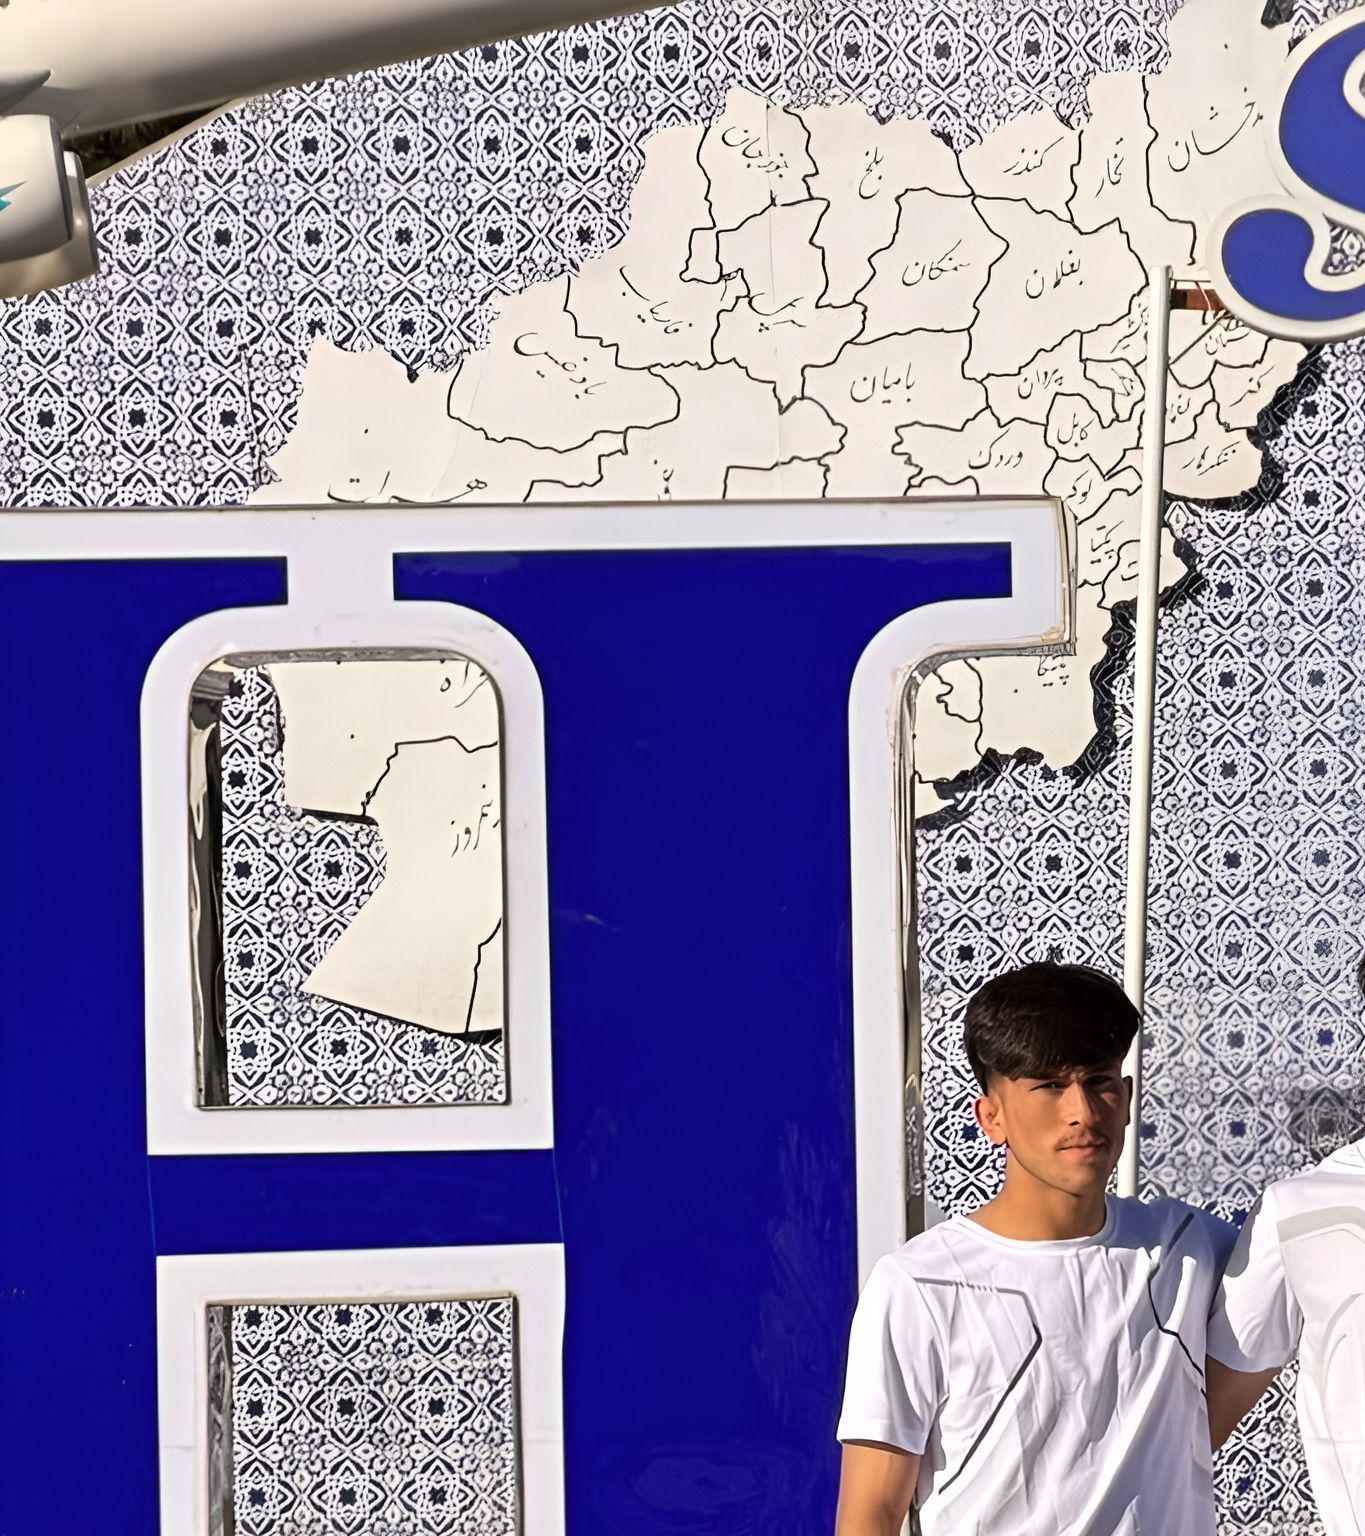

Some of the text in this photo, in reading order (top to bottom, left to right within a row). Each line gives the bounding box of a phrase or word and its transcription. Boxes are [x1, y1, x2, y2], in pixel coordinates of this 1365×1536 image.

[858, 146, 884, 200] بلخ
[850, 362, 916, 404] بامیان
[1056, 412, 1096, 448] کابل
